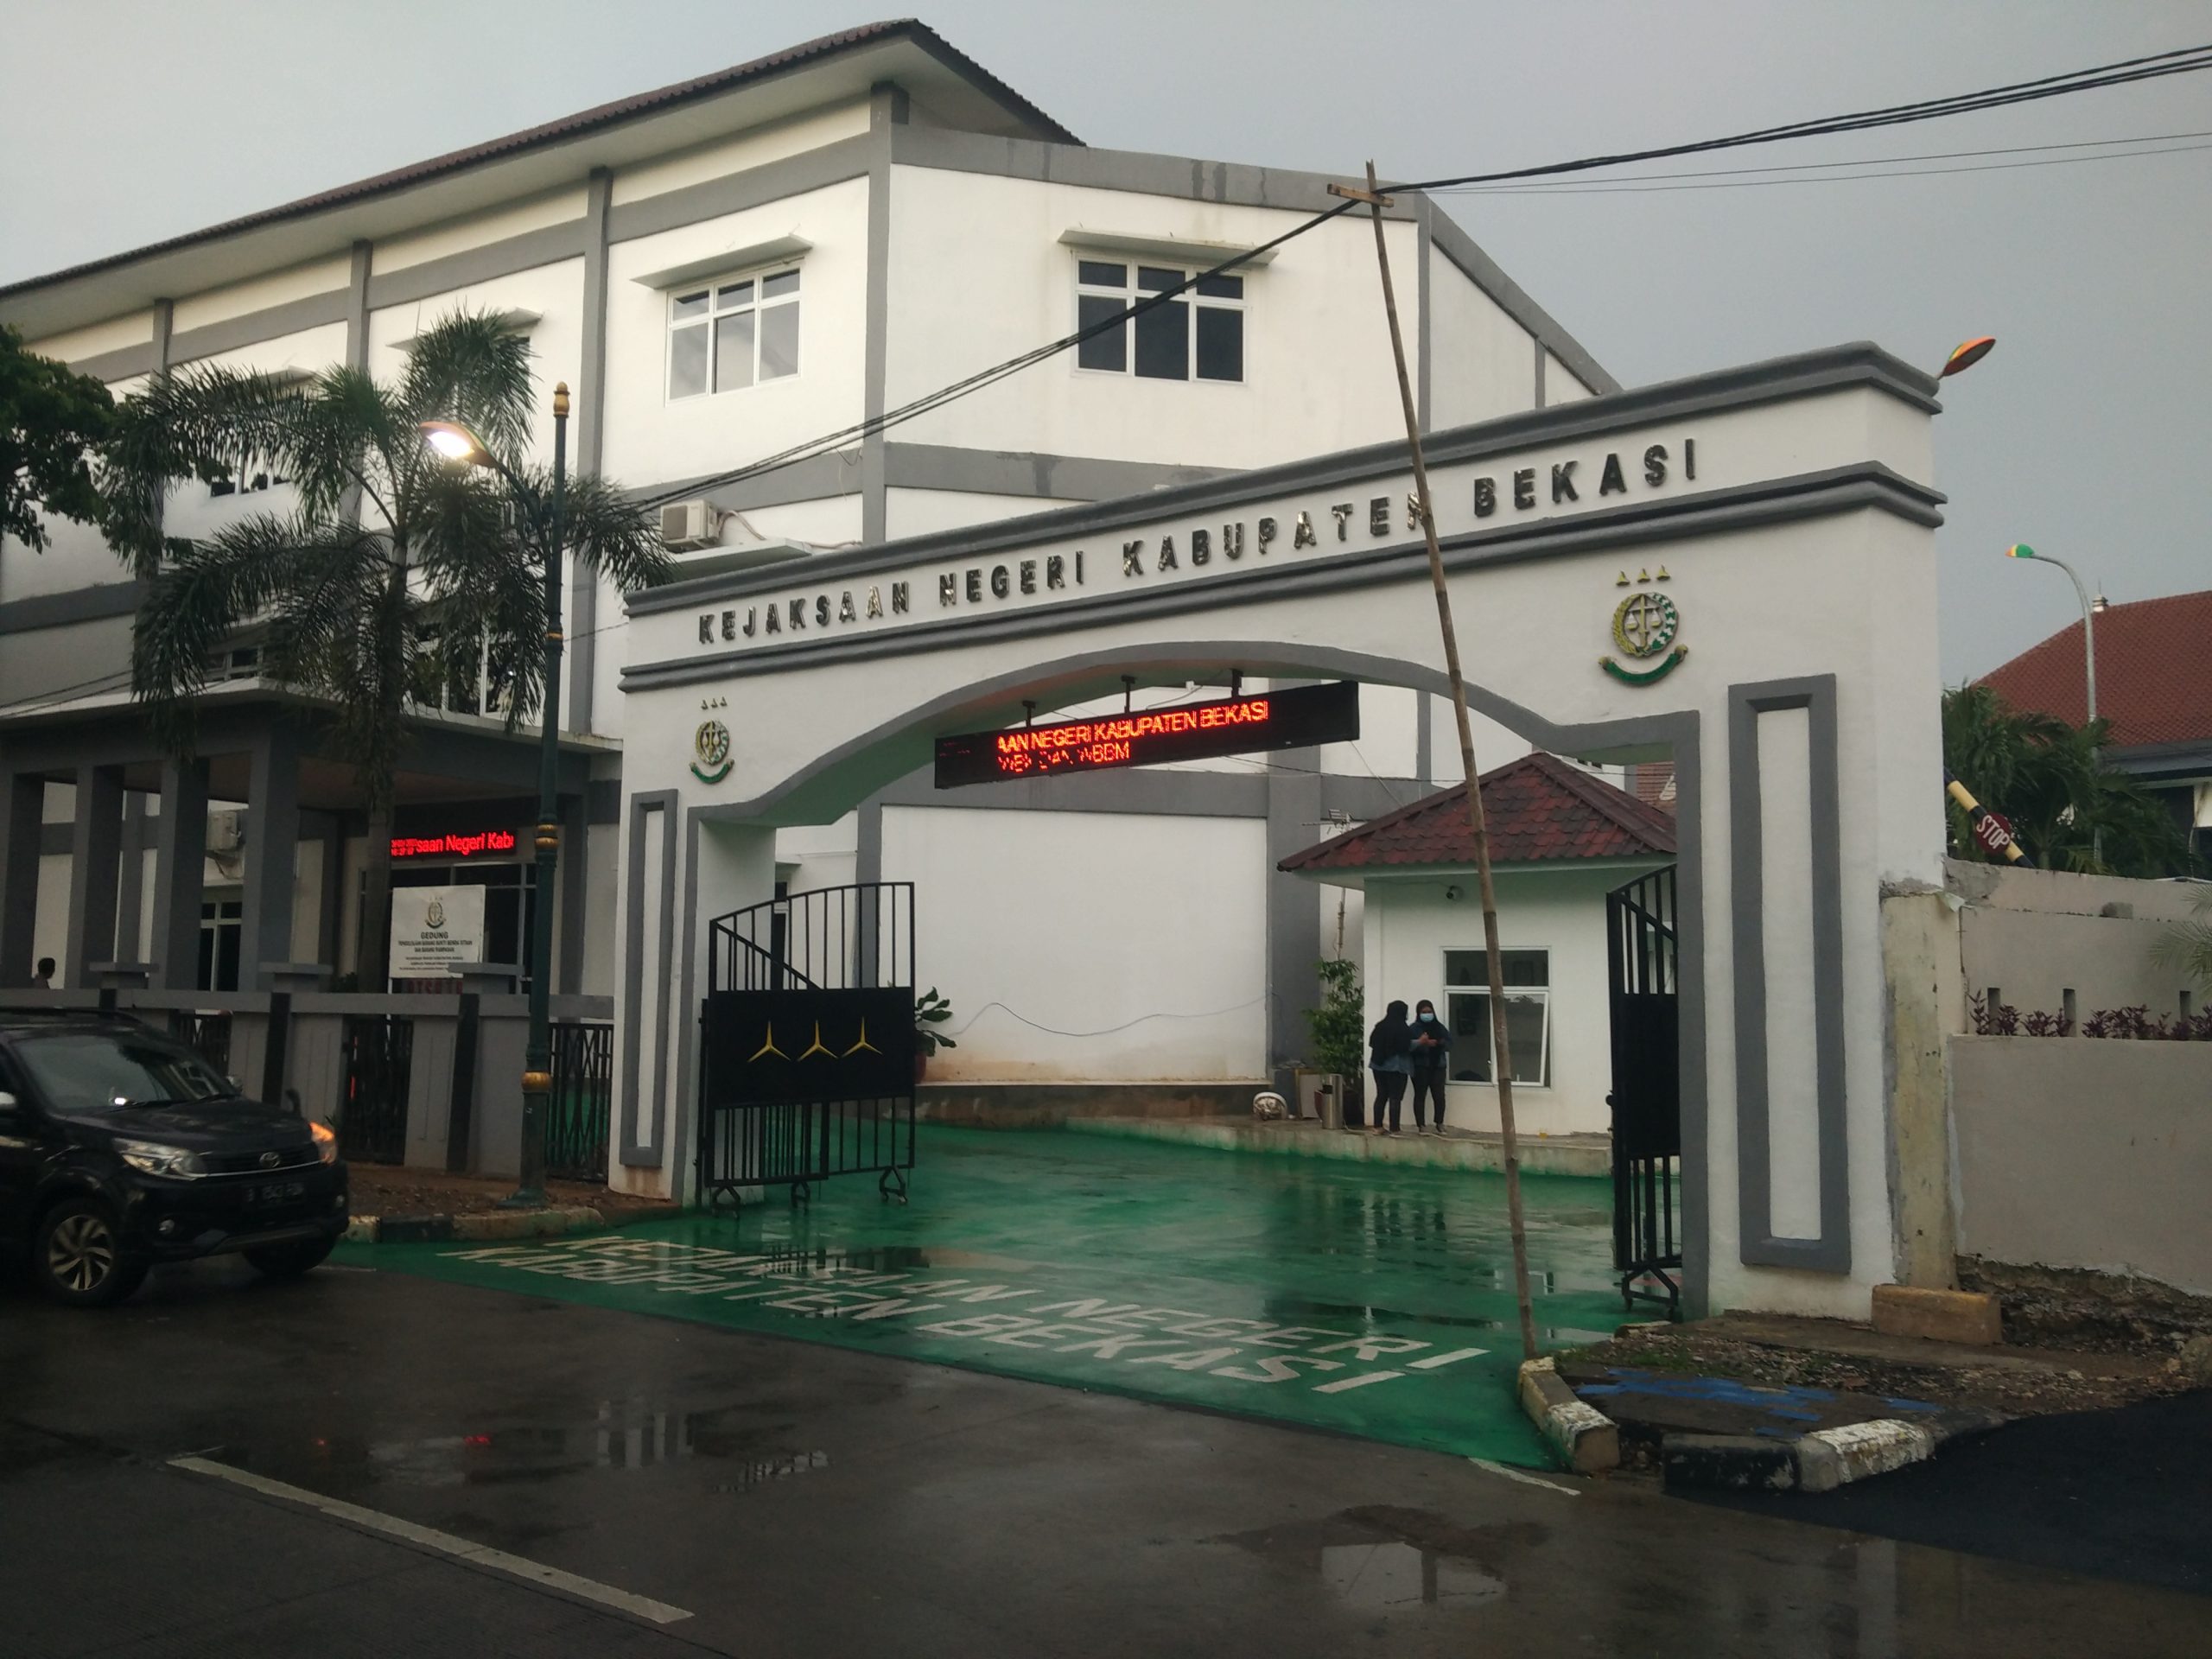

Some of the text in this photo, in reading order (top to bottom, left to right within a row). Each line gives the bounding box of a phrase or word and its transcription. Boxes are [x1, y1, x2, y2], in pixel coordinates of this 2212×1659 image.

[698, 437, 1696, 645] KEJAKSAAN NEGERI KABUPATEN BEKASI
[1030, 724, 1092, 749] NEGERI
[1094, 712, 1198, 743] KABUPATEN
[1199, 699, 1269, 727] BEKASI
[446, 832, 485, 855] Negeri
[1975, 814, 2011, 850] STOP
[421, 931, 449, 940] GEDUNG
[436, 1246, 1407, 1395] KABUPATEN BEKASI
[543, 1236, 1491, 1370] KEJAKSAAN NEGERI
